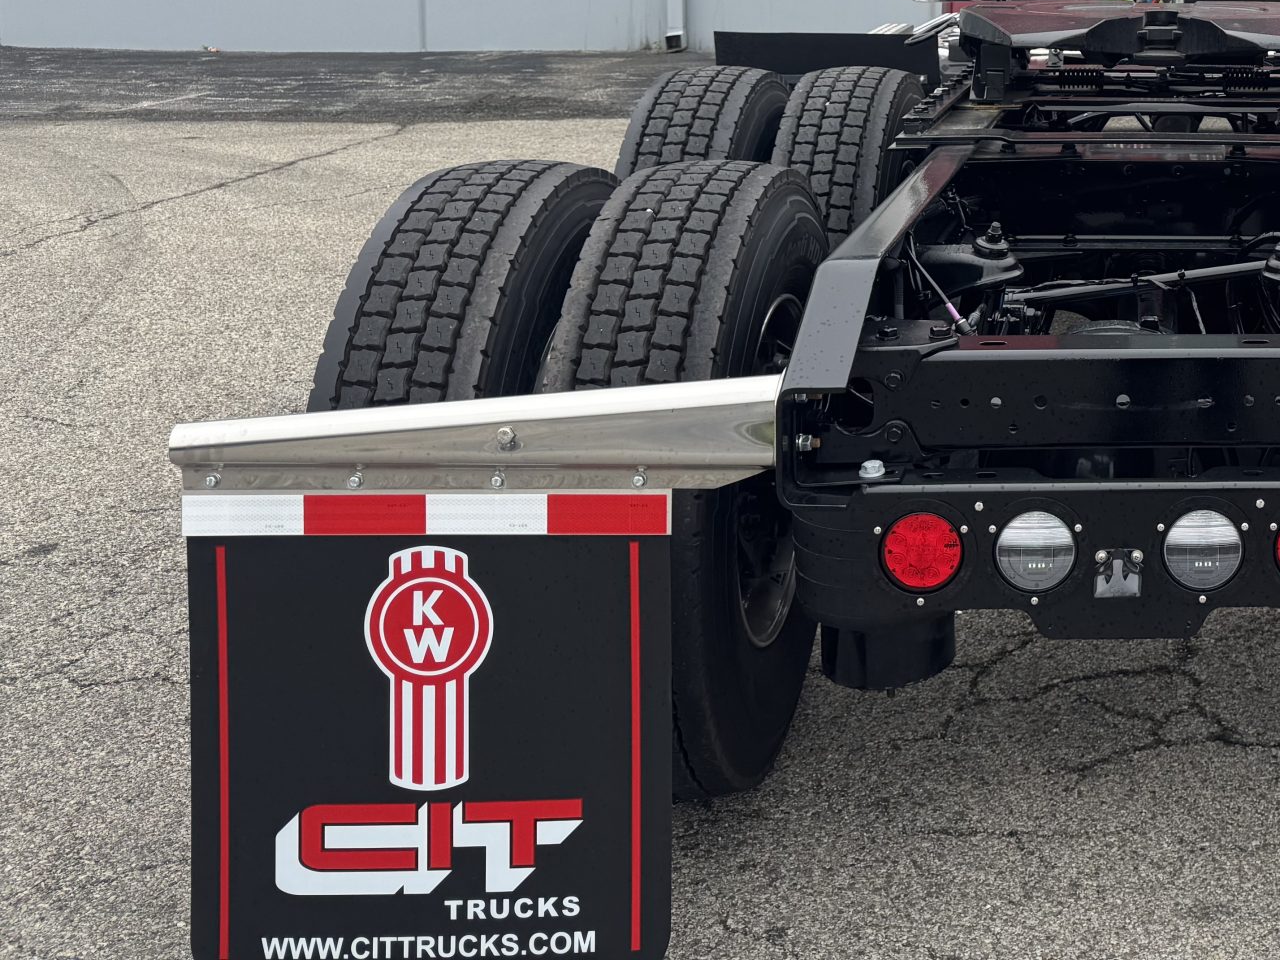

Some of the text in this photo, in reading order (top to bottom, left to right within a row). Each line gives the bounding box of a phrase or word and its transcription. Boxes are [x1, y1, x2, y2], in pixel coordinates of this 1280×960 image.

[298, 798, 584, 872] CIT
[444, 896, 581, 921] TRUCKS
[262, 931, 596, 960] WWW.CITTRUCKS.COM
